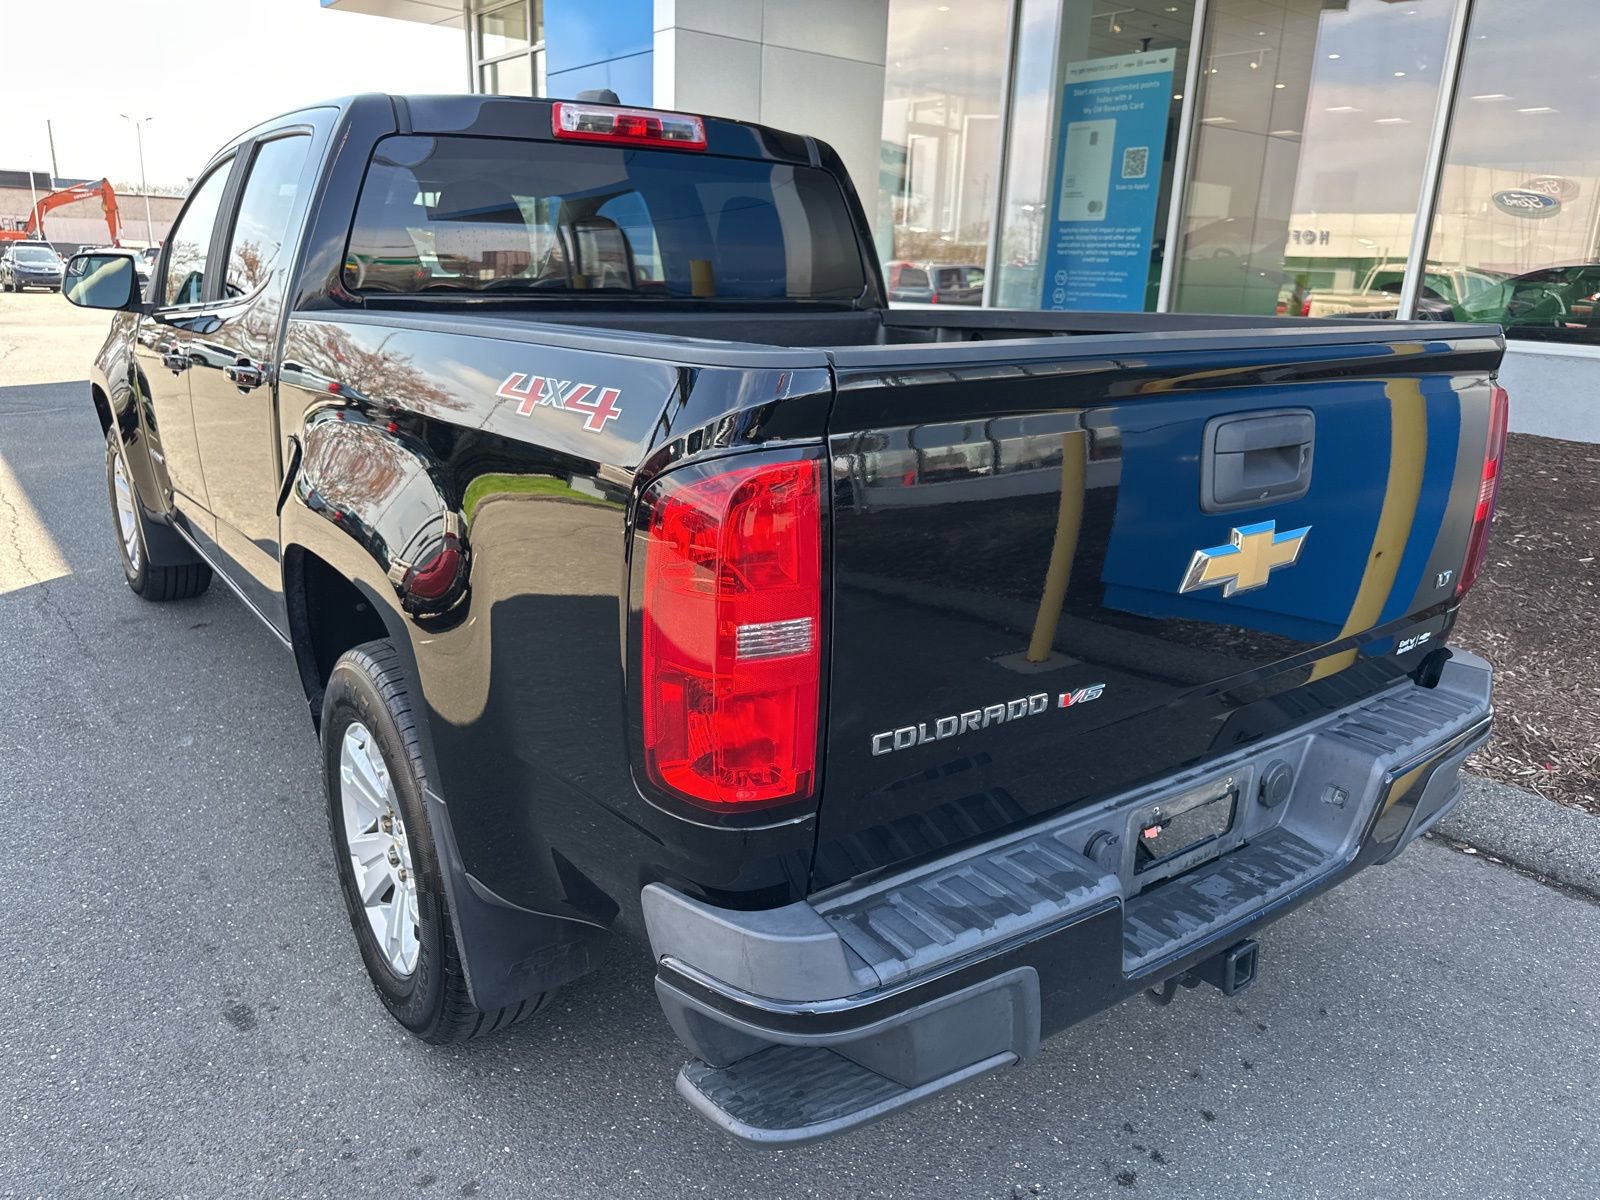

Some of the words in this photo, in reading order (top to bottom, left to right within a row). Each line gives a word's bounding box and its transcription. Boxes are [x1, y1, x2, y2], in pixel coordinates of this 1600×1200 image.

[1435, 570, 1452, 589] LT
[1058, 684, 1106, 708] V6
[872, 692, 1049, 756] COLORADO
